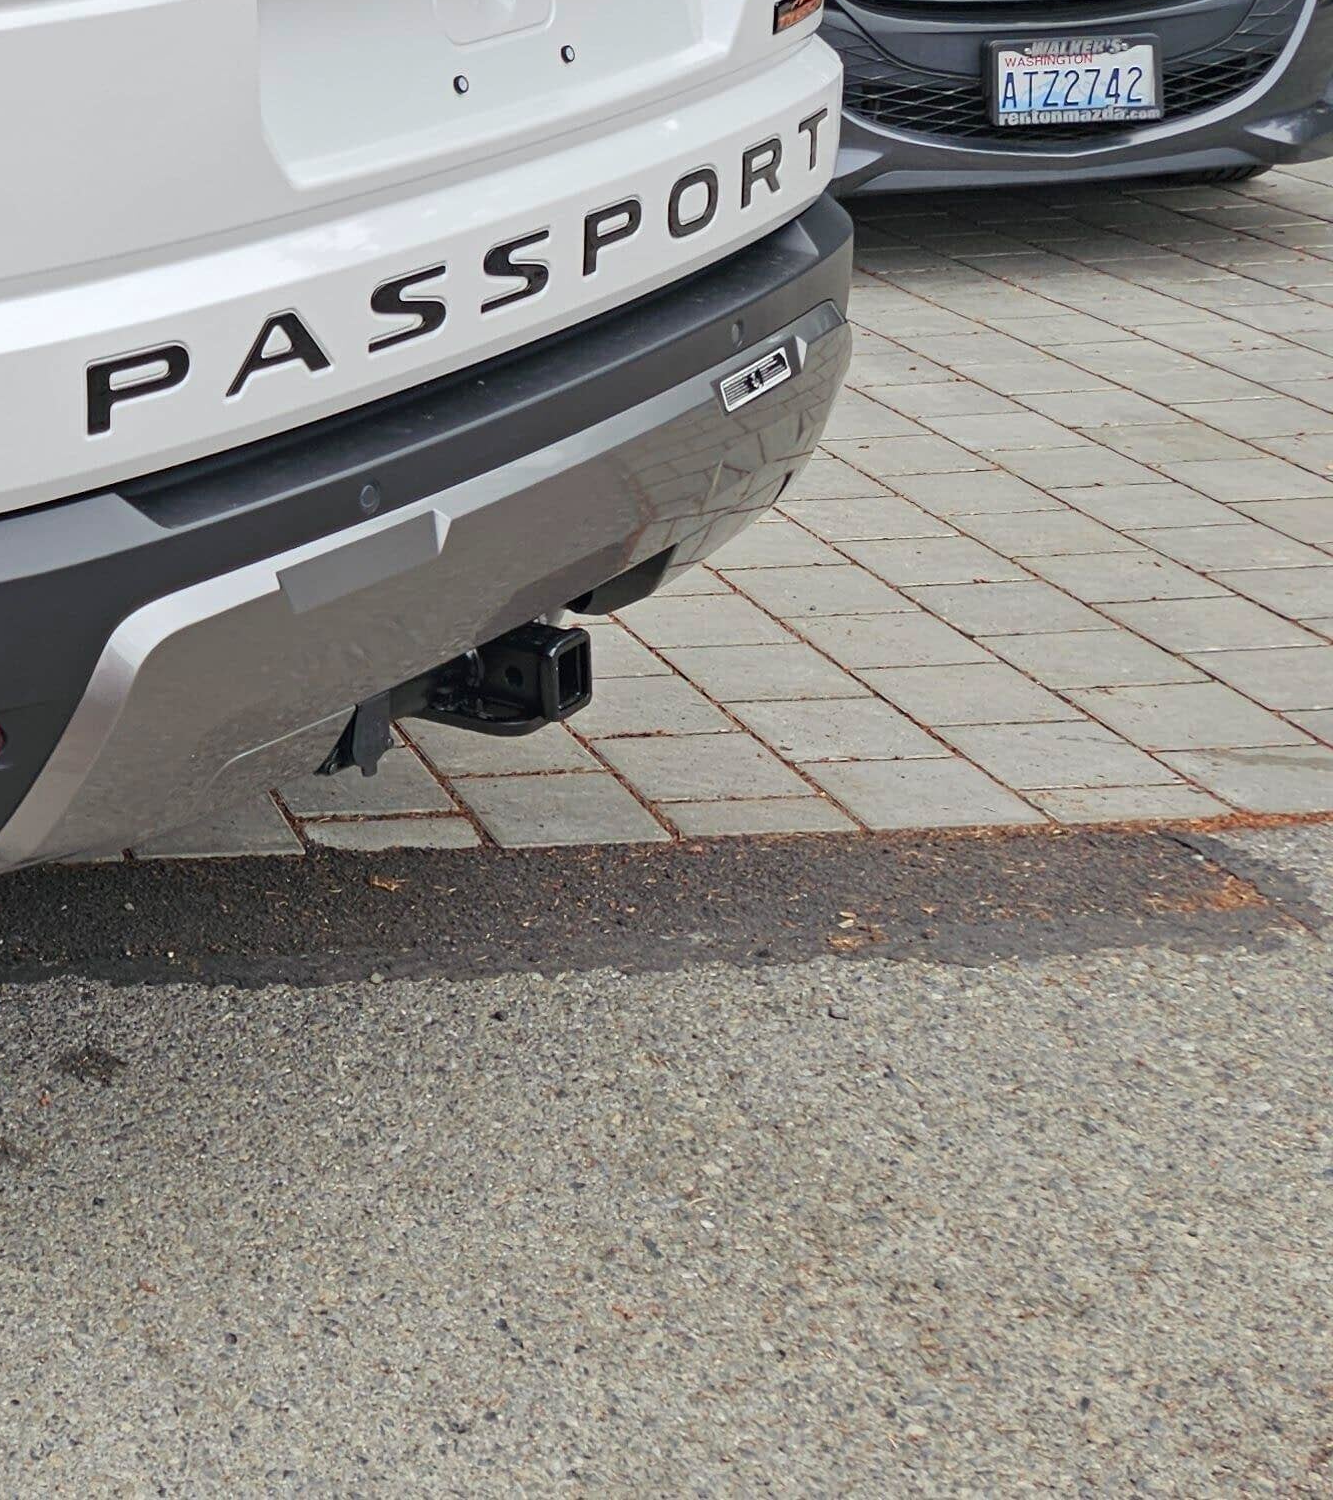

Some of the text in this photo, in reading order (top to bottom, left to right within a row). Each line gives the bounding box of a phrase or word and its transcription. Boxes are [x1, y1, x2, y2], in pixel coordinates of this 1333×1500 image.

[1029, 37, 1122, 56] WALKER'S
[1004, 53, 1093, 68] WASHINGTON
[1001, 65, 1144, 109] ATZ2742
[998, 104, 1161, 127] rentonmazda.com
[85, 106, 829, 437] PASSPORT
